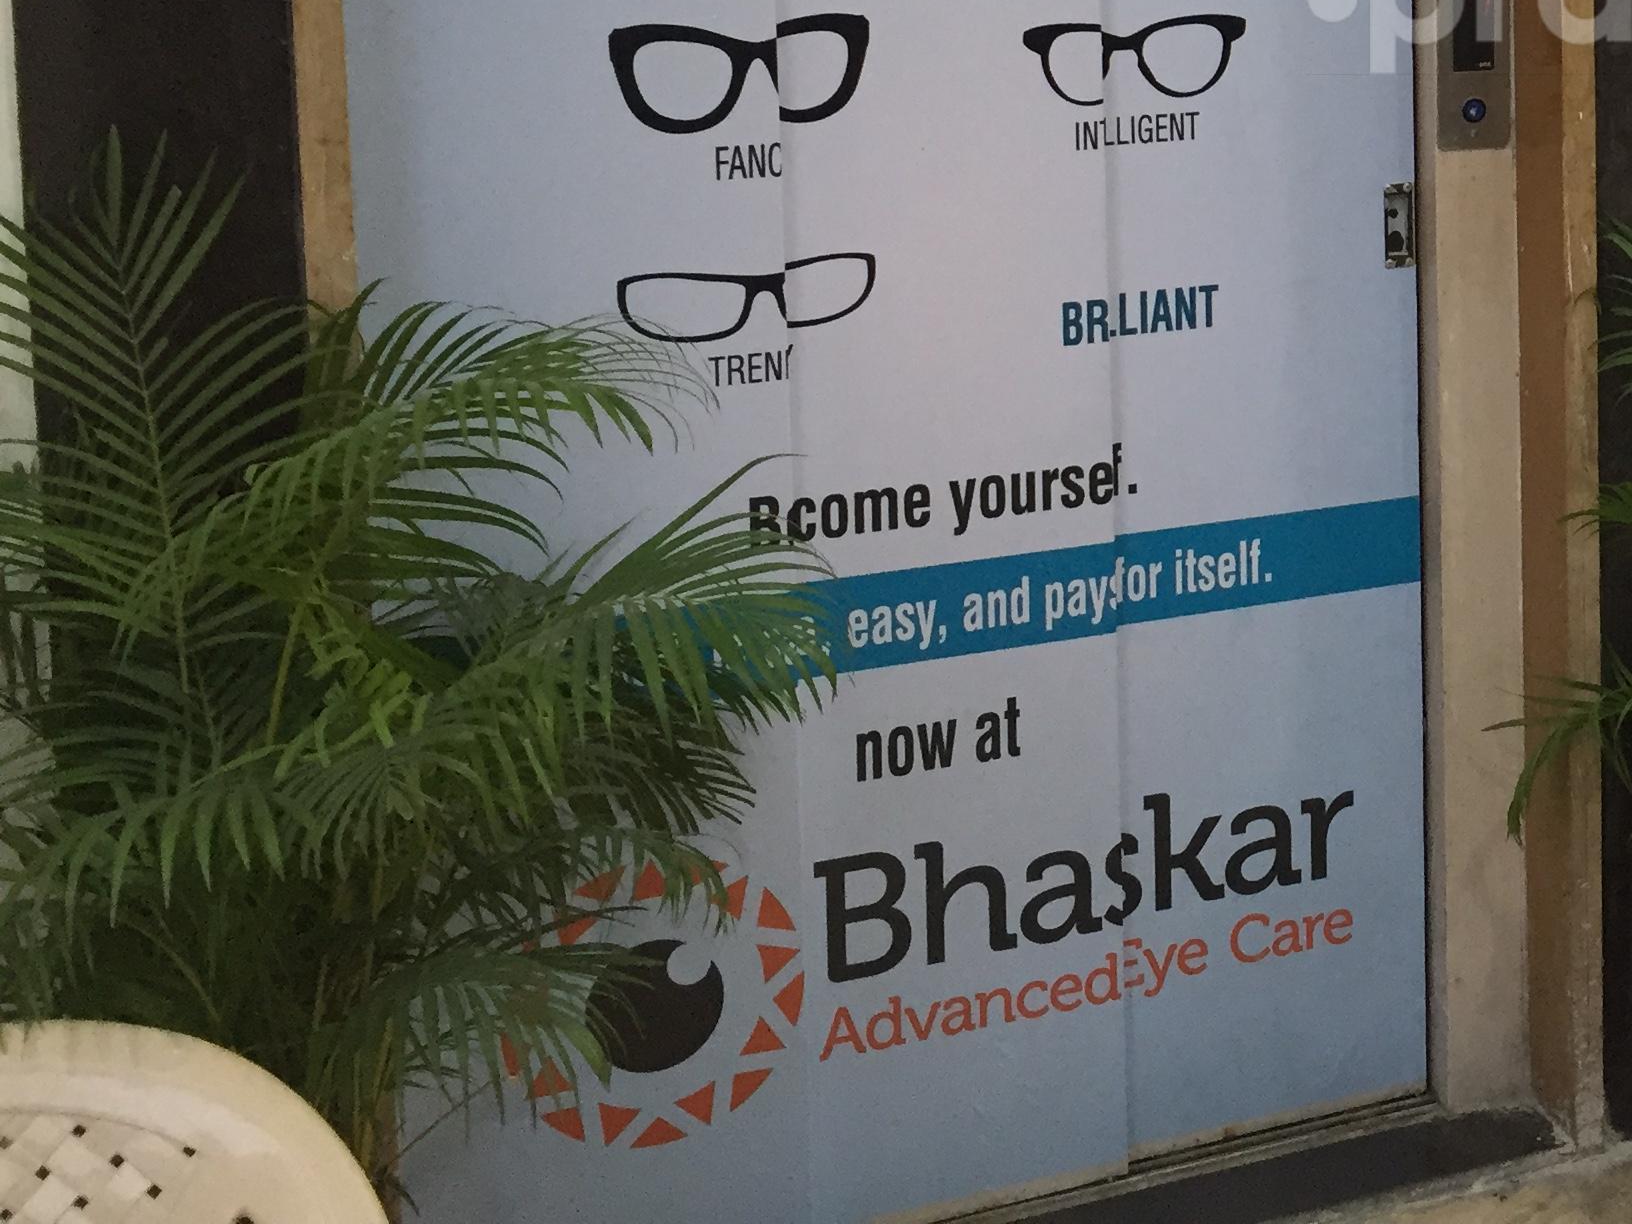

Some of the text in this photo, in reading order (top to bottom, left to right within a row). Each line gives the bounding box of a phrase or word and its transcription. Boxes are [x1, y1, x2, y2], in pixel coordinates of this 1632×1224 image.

[847, 598, 947, 651] easy,
[963, 575, 1031, 632] and
[1114, 556, 1163, 603] for
[1174, 538, 1273, 596] itself.
[855, 696, 1021, 782] now at
[813, 789, 1354, 983] Bhaskar
[1229, 908, 1354, 964] Care
